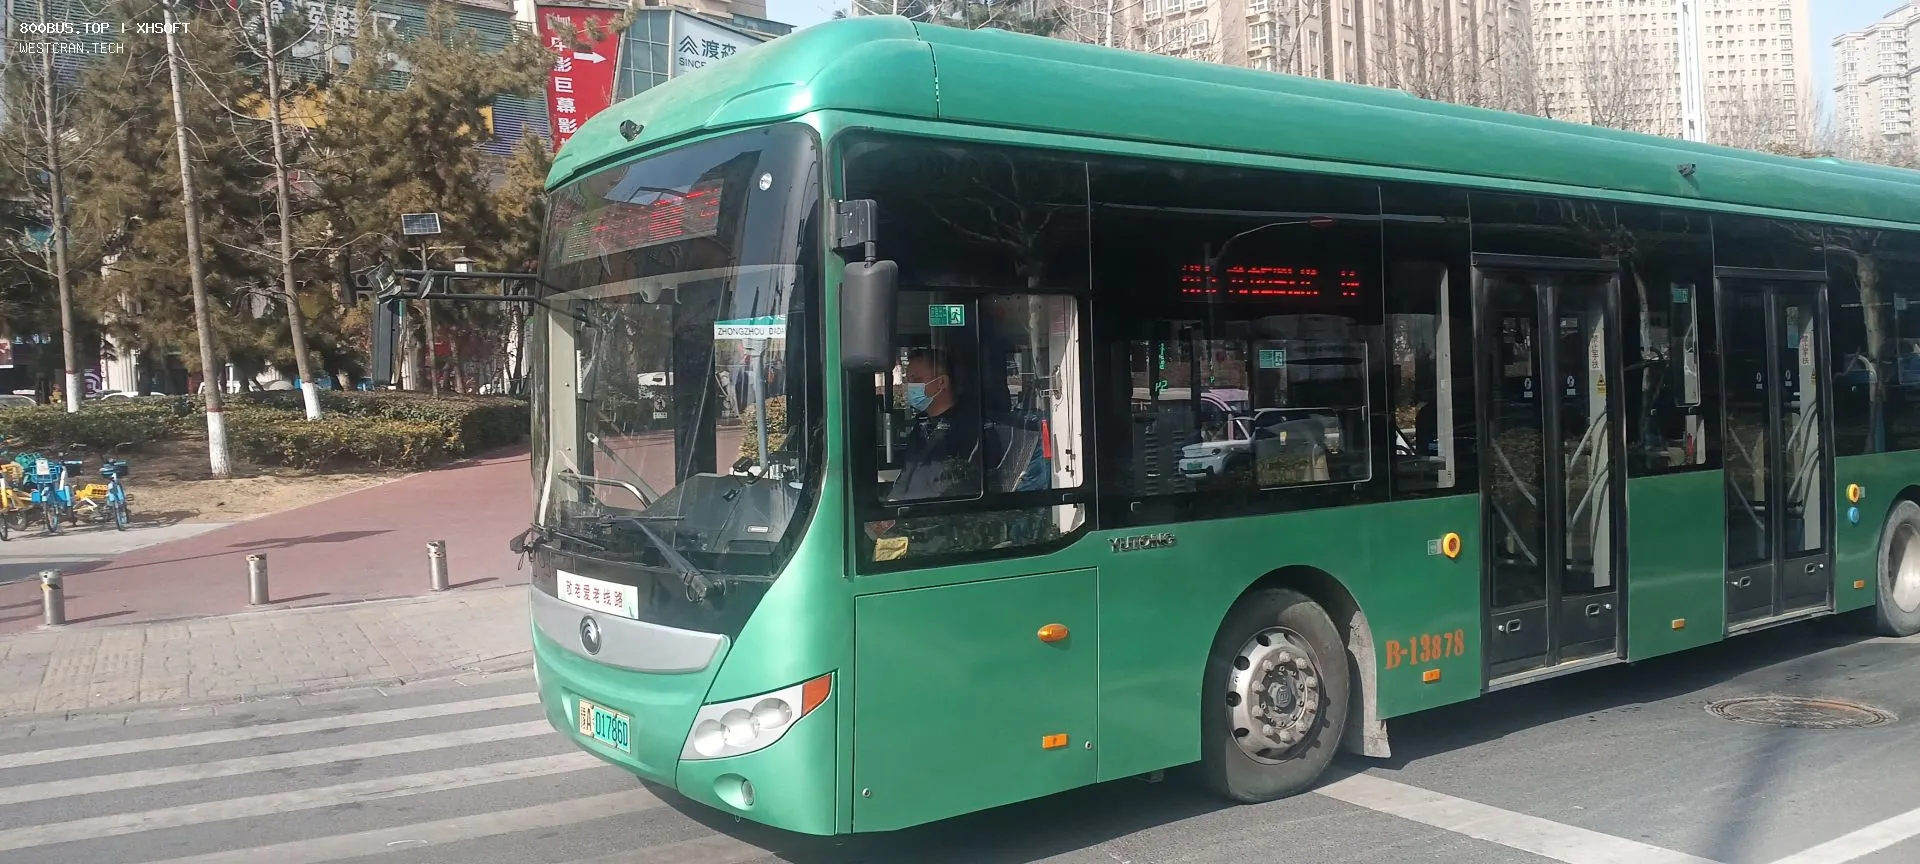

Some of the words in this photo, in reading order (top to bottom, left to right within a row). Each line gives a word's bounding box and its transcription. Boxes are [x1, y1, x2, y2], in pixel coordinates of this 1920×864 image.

[717, 327, 765, 336] ZHONGZHOU
[1107, 532, 1177, 553] YUTONG
[1385, 628, 1465, 670] B-13878
